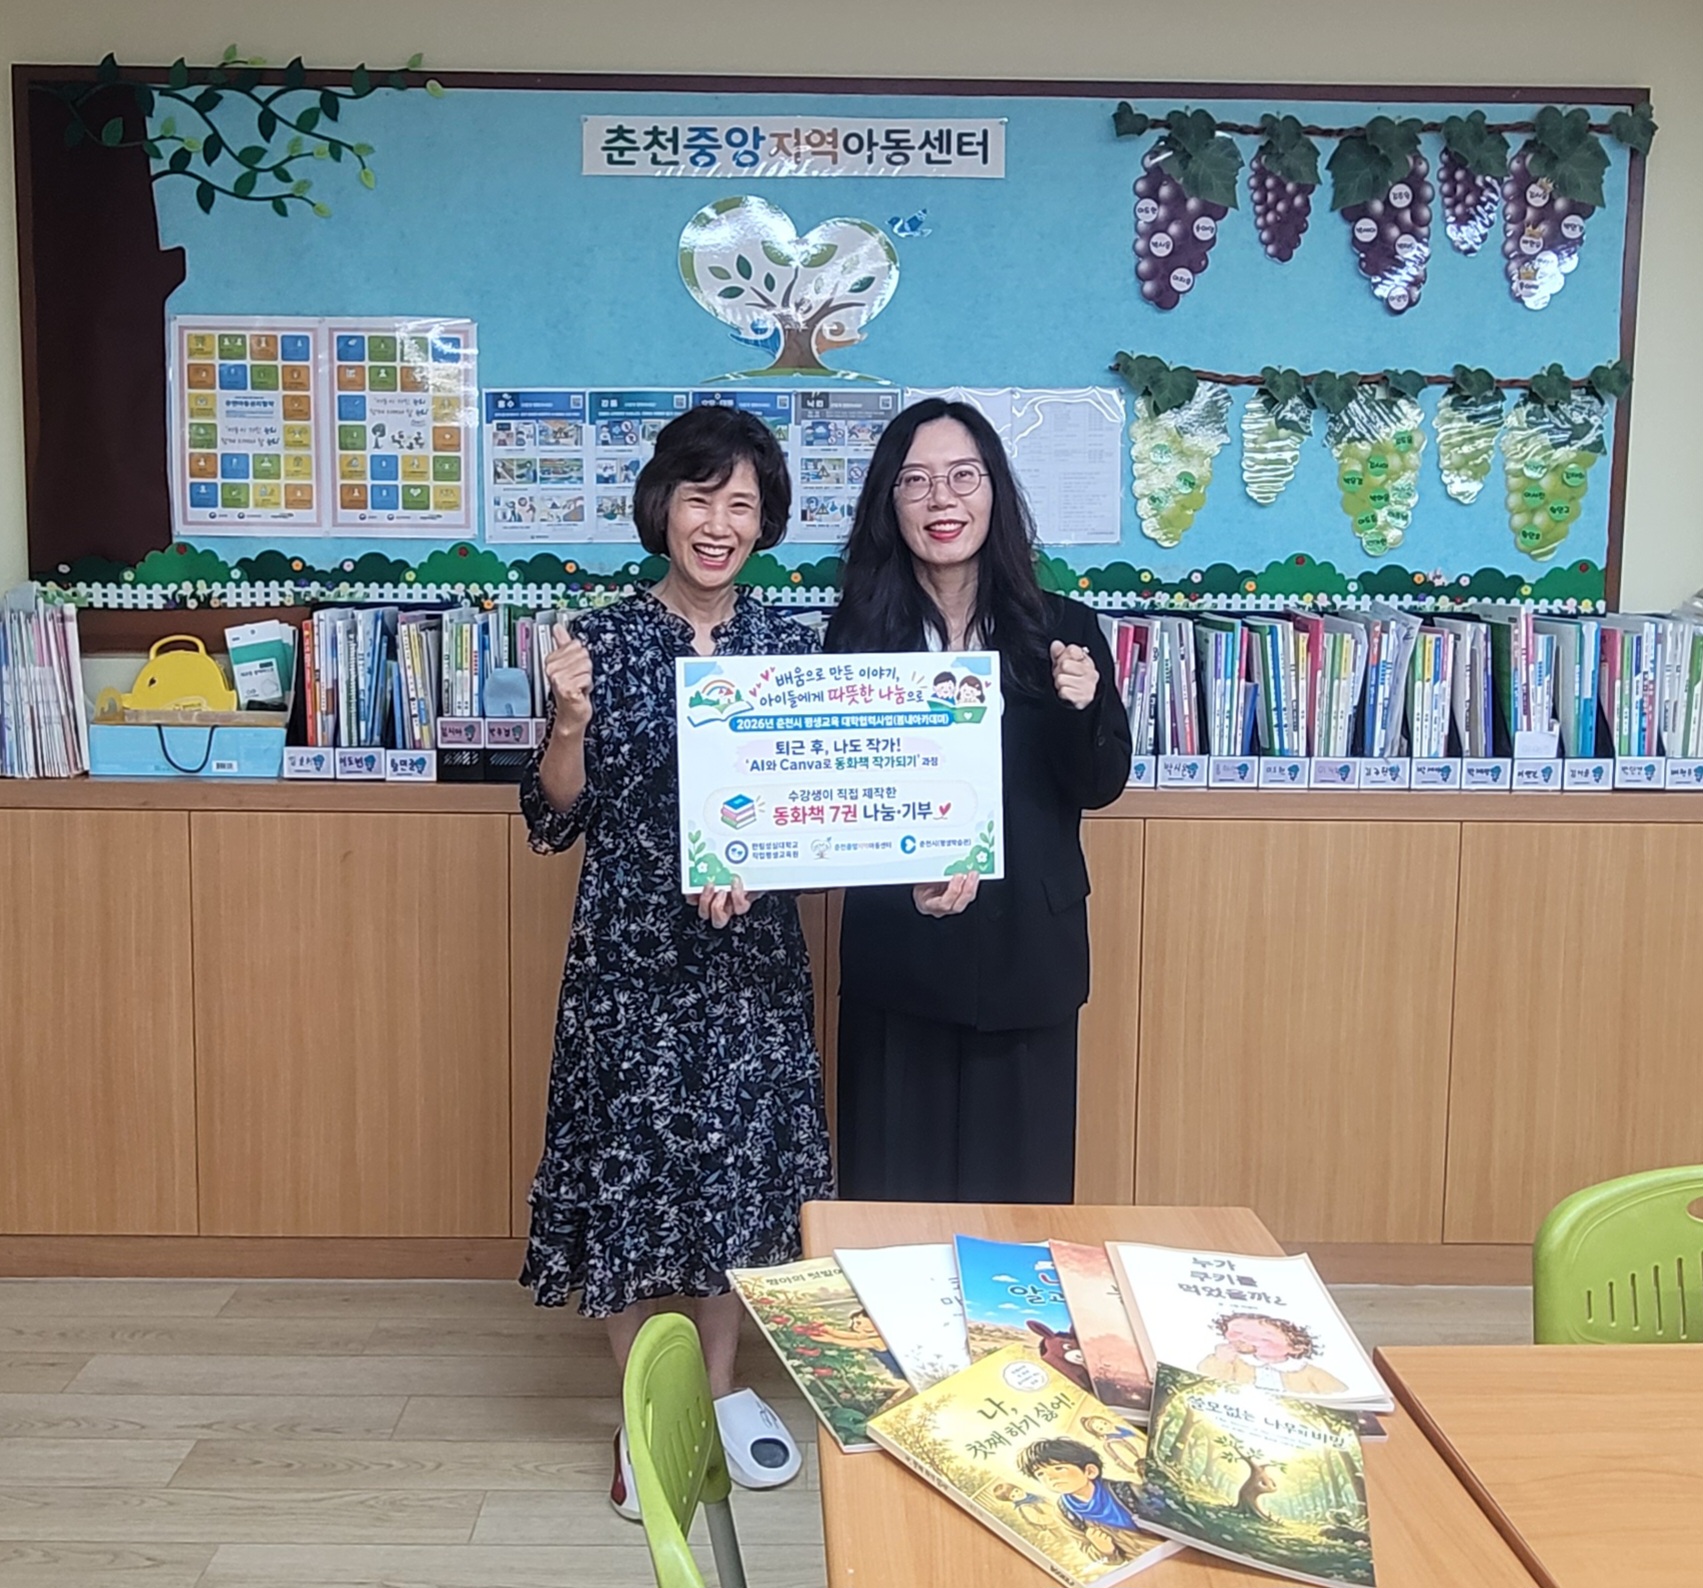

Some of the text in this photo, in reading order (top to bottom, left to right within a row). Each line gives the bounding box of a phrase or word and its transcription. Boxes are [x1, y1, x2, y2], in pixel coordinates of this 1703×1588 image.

[600, 124, 990, 168] 춘천중앙지역아동센터
[775, 665, 900, 687] 배움으로 만든 이야기,
[760, 684, 924, 708] 아이들에게 따뜻한 나눔으로
[737, 718, 774, 730] 2026년
[776, 717, 802, 729] 춘천시
[804, 716, 839, 728] 평생교육
[775, 737, 901, 755] 퇴근 후, 나도 작가!
[780, 758, 832, 771] Canva로
[835, 756, 869, 770] 동화책
[922, 756, 938, 767] 과정
[788, 787, 897, 802] 수강생이 직접 제작한
[773, 801, 933, 826] 동화책 7권 나눔·기부
[1192, 1257, 1236, 1271] 누가
[1190, 1270, 1258, 1288] 쿠키를
[977, 1397, 1018, 1420] 나,
[1187, 1395, 1255, 1423] 쓸모없는
[965, 1392, 1075, 1460] 첫째 하기 싫어!
